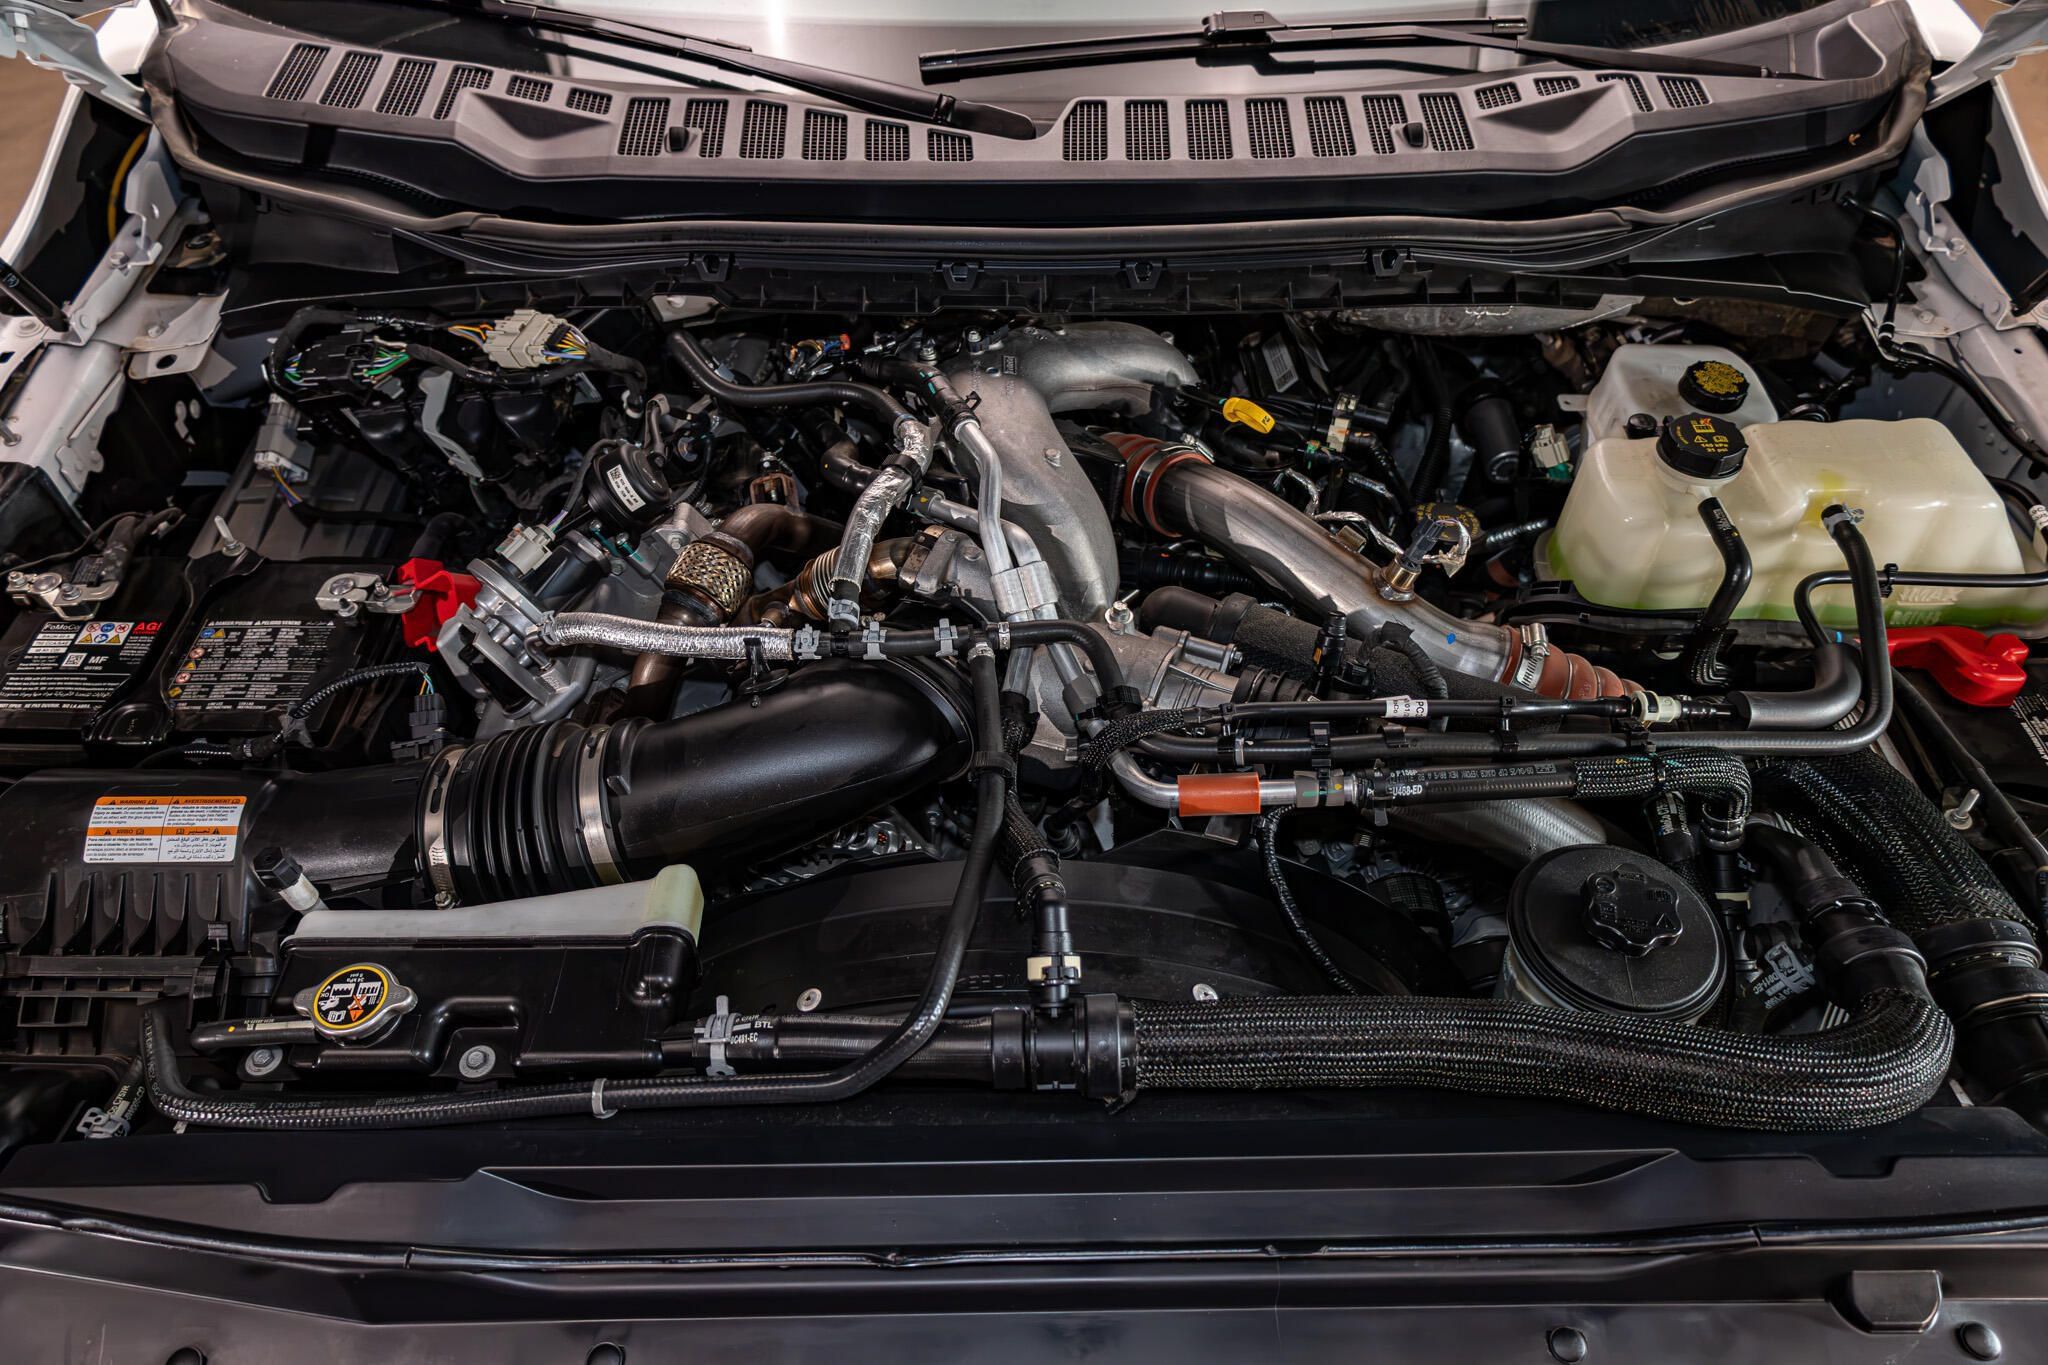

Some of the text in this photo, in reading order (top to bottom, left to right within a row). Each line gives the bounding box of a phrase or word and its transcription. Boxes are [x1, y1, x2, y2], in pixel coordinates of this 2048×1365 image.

[134, 622, 162, 631] AG
[88, 656, 109, 665] MF
[1390, 785, 1422, 796] U468-ED
[754, 1021, 774, 1029] BTL
